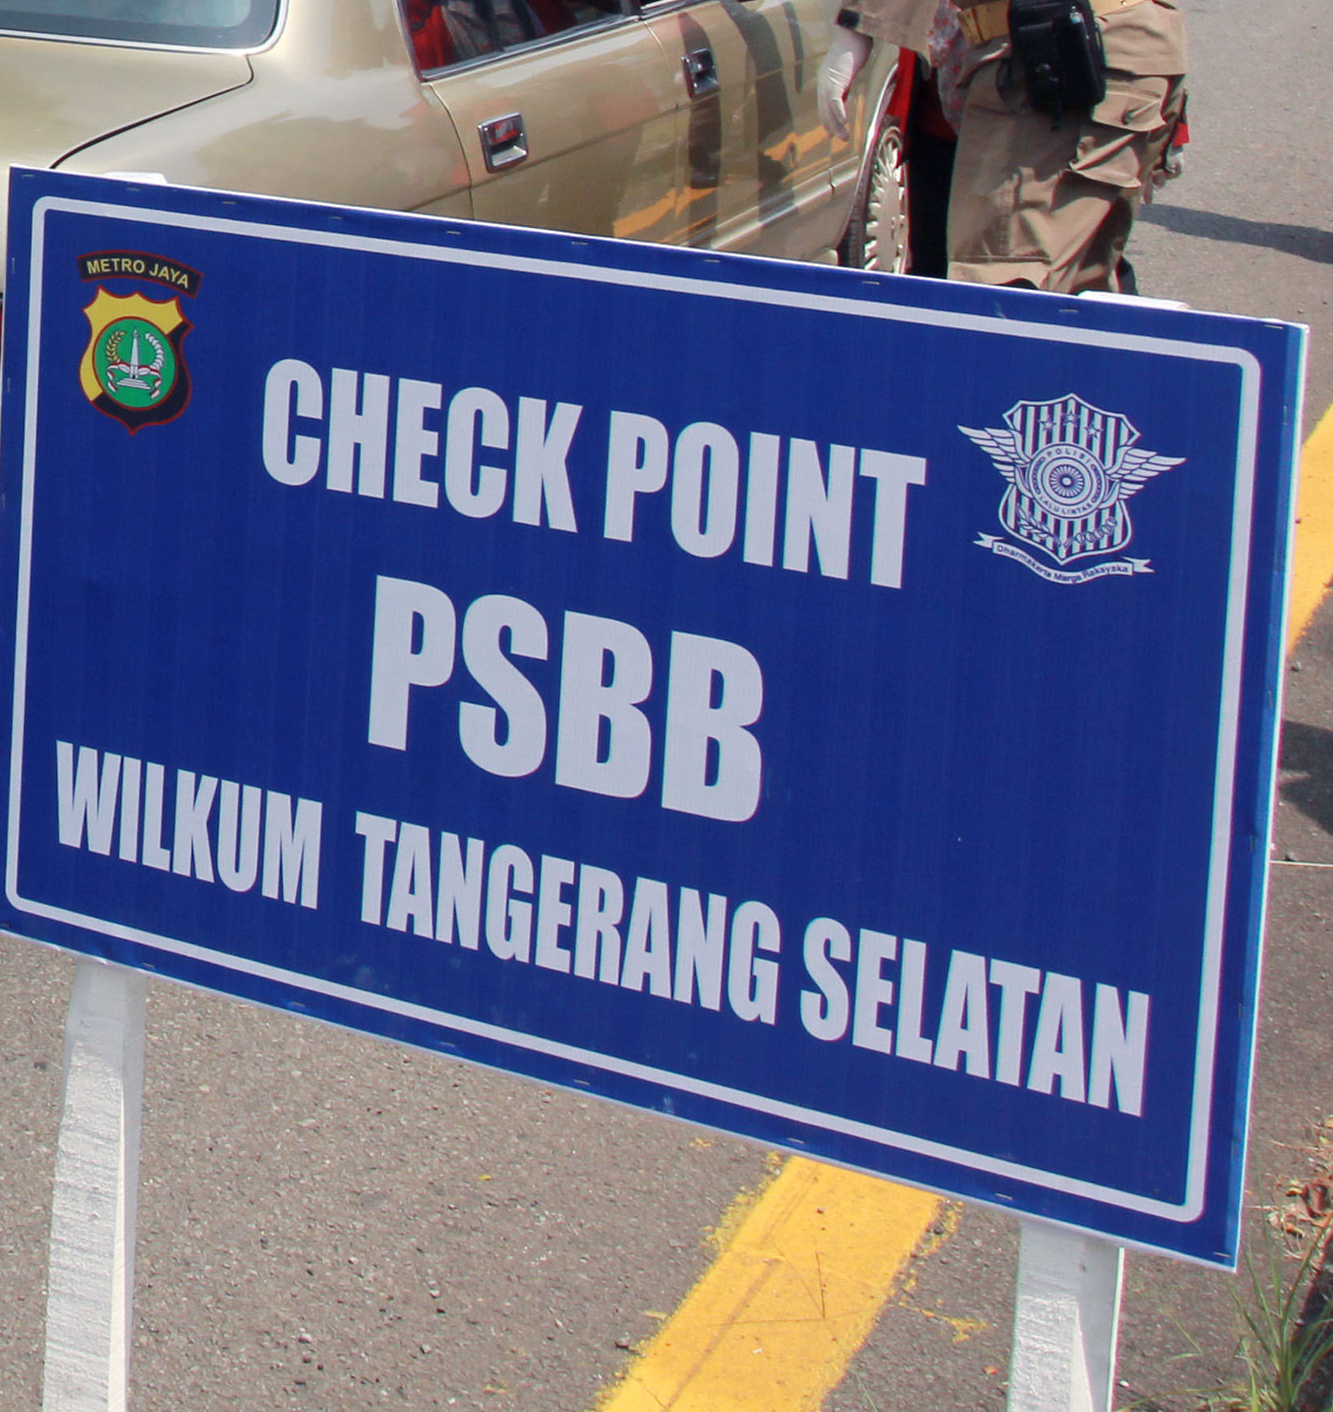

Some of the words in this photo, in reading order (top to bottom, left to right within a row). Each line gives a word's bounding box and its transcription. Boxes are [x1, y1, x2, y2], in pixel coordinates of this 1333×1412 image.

[86, 257, 146, 275] METRO
[149, 263, 189, 288] JAYA
[1046, 448, 1091, 464] POLISI
[263, 359, 582, 532] CHECK
[604, 411, 927, 588] POINT
[1038, 495, 1061, 514] LALU
[1061, 502, 1093, 516] LINTAS
[1053, 572, 1082, 585] Marga
[369, 576, 764, 822] PSBB
[57, 742, 323, 910] WILKUM
[356, 813, 780, 1026] TANGERANG
[801, 918, 1150, 1118] SELATAN
